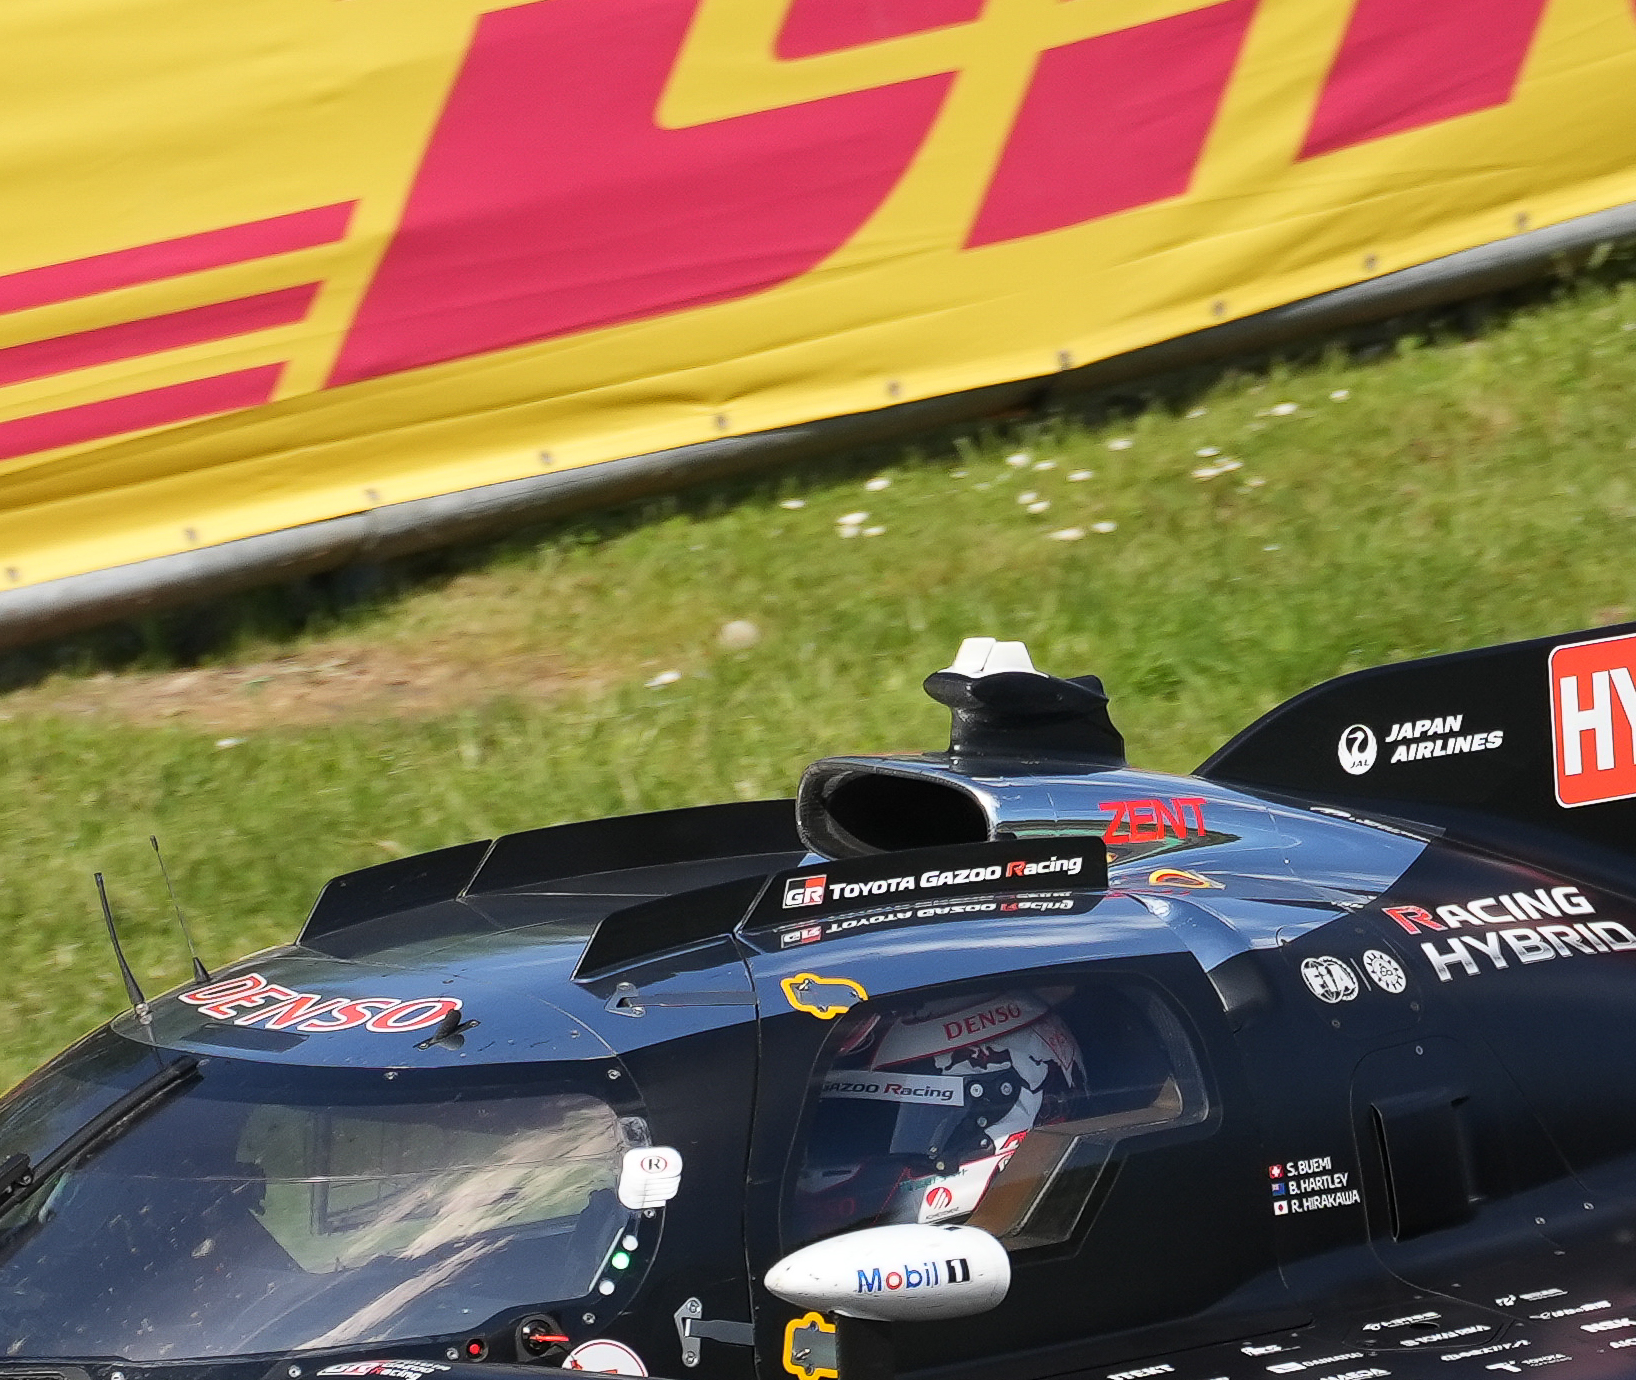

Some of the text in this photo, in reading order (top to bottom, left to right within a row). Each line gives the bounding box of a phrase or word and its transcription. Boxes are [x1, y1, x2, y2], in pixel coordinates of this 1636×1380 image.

[1385, 714, 1463, 743] JAPAN
[1390, 730, 1504, 764] AIRLINES
[1350, 758, 1370, 769] JAL
[1098, 797, 1208, 844] ZENT
[785, 856, 1083, 907] GR TOYOTA GAZOO Racing
[1382, 886, 1596, 935] RACING
[177, 973, 463, 1033] DENSO
[943, 1000, 1022, 1041] DENSO
[883, 1082, 954, 1101] Racing
[856, 1259, 966, 1294] Mobil 1
